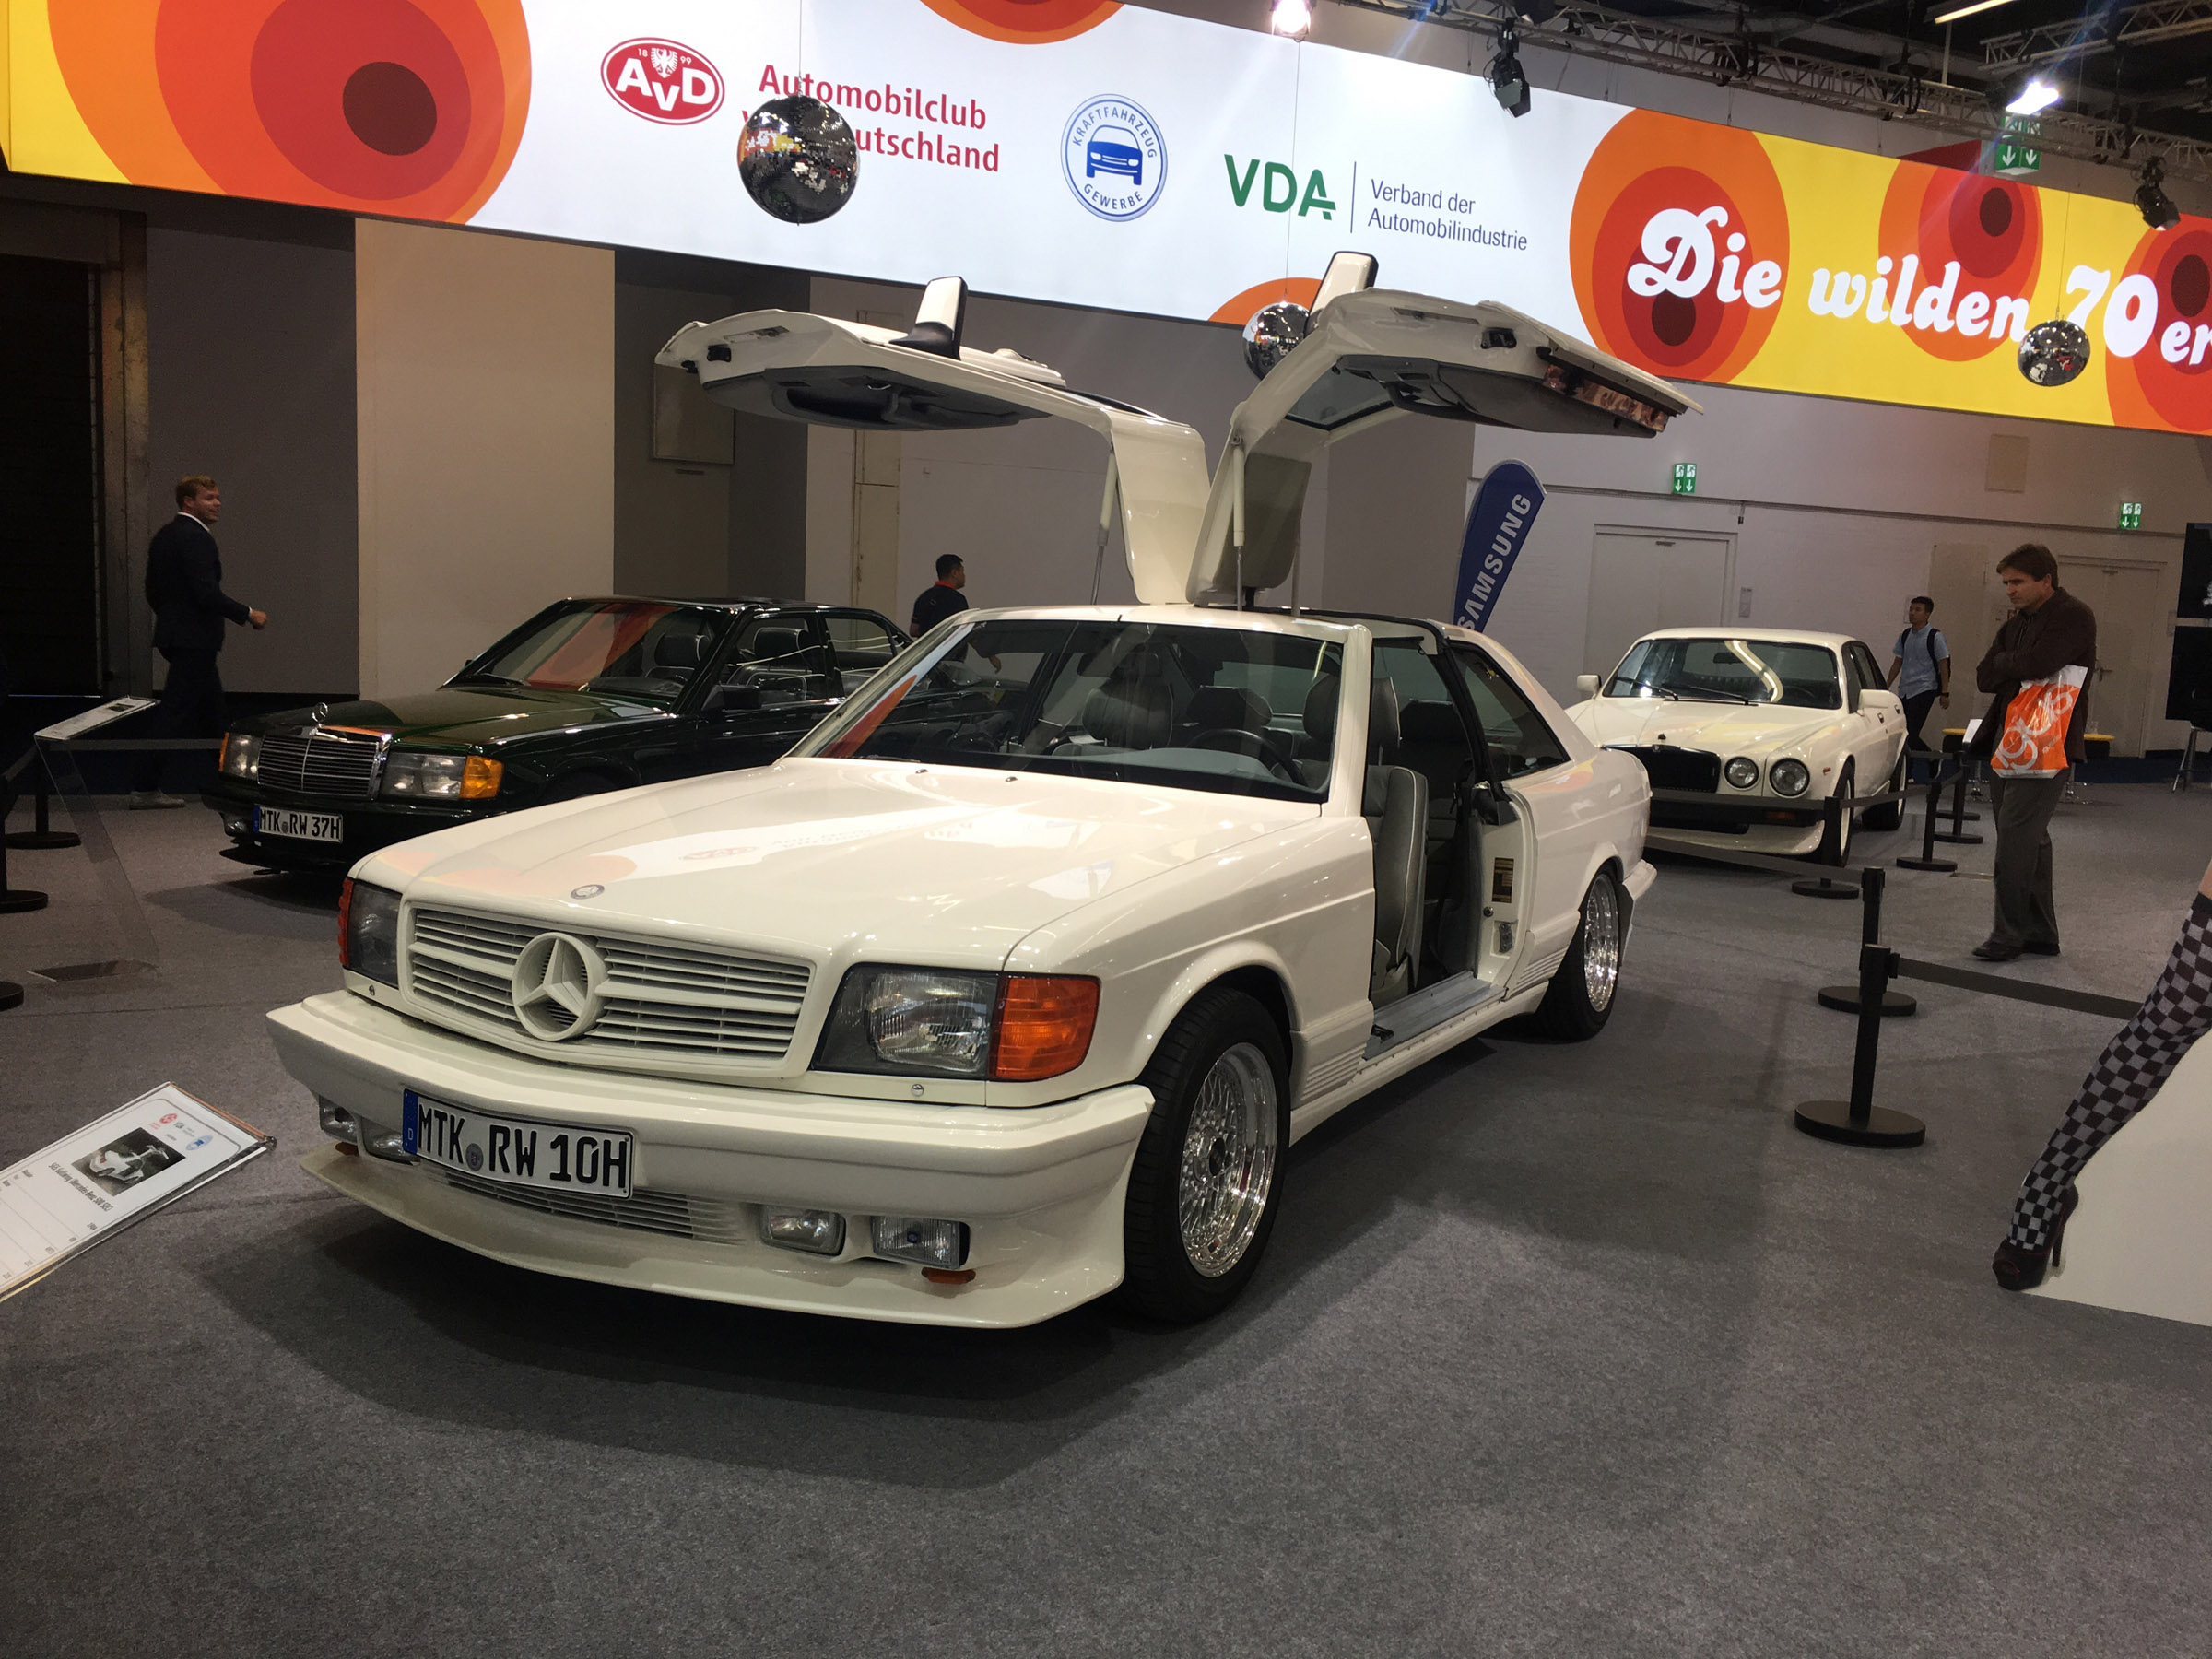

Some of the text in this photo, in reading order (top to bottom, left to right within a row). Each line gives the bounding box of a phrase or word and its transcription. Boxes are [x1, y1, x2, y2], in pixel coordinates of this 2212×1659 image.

[638, 48, 692, 65] 18 99
[759, 65, 986, 130] Automobilclub
[853, 127, 999, 172] utschland
[1072, 106, 1158, 159] KRAFTFAHRZEUG
[1083, 183, 1144, 210] GEWERBE
[1224, 154, 1336, 221] VDA
[1371, 178, 1476, 215] Verband der
[1368, 207, 1528, 251] Automobilindustrie
[1627, 206, 1783, 309] Die
[1807, 253, 2030, 342] wilden
[260, 809, 340, 840] MTK RW 37H
[418, 1103, 628, 1189] MTK RW 10H
